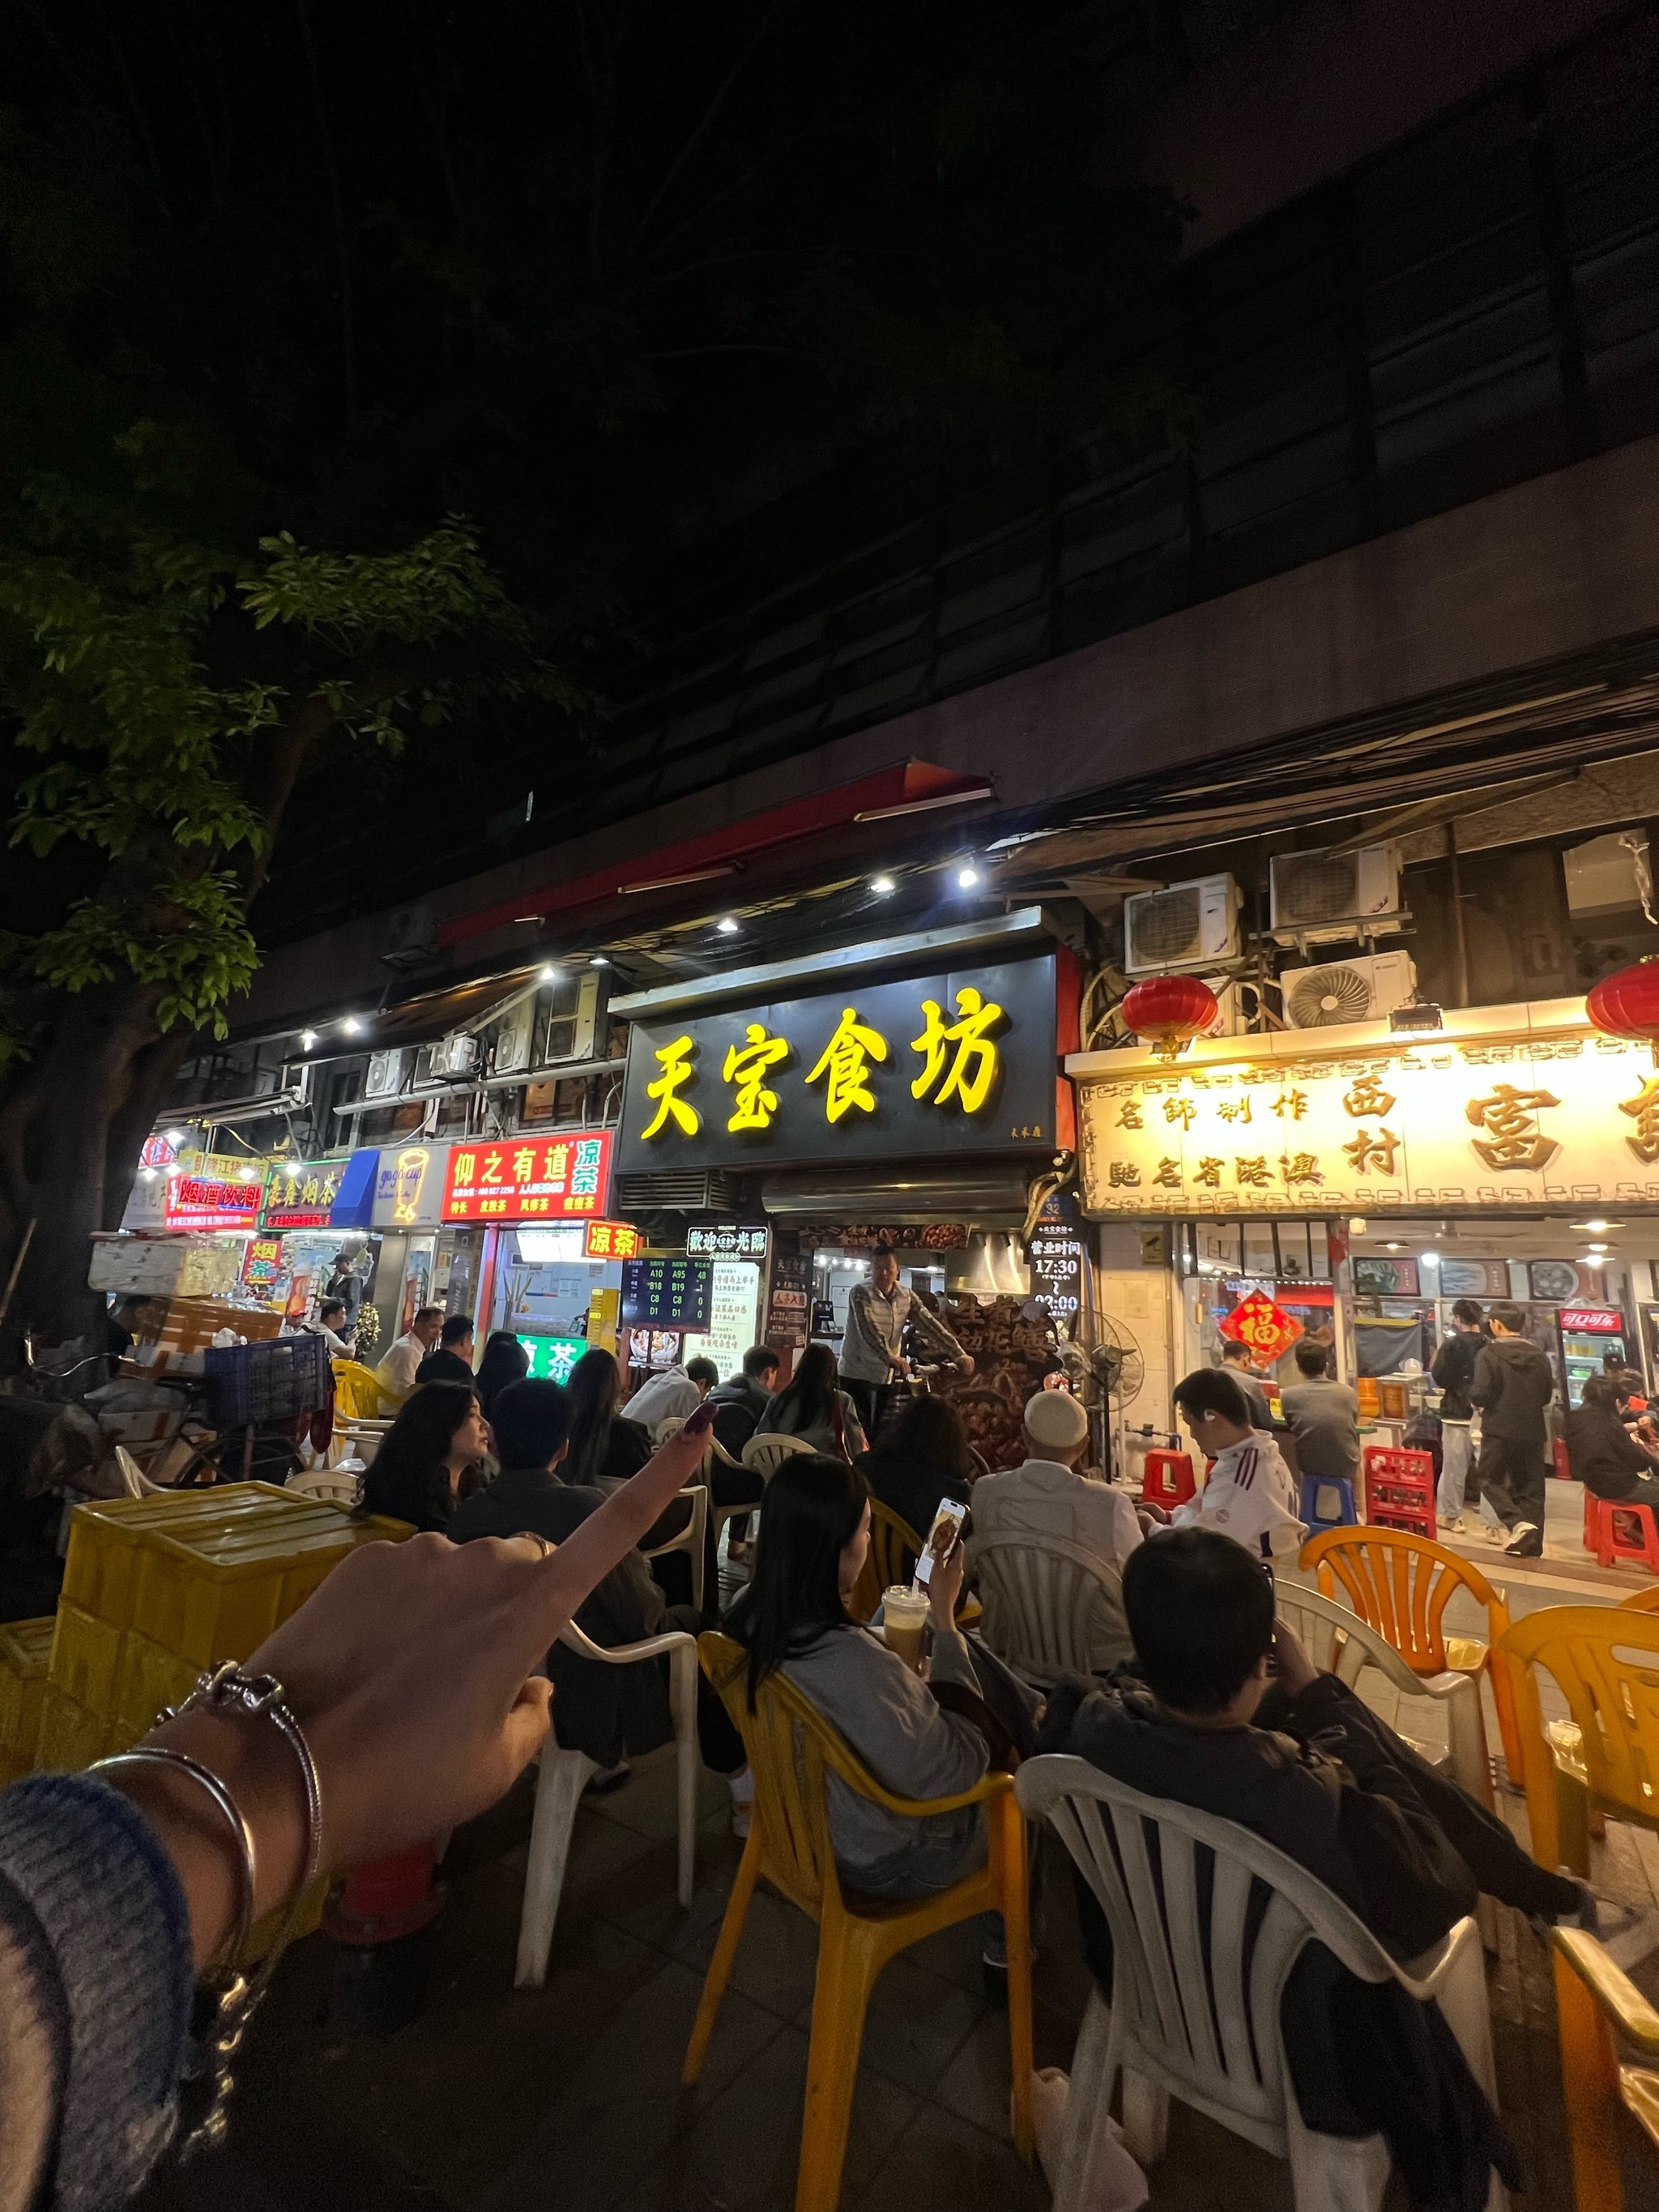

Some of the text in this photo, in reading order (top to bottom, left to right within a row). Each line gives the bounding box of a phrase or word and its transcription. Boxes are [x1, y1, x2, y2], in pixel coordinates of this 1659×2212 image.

[640, 987, 1003, 1140] 天宝食坊
[1341, 1075, 1402, 1177] 西村
[454, 1143, 569, 1186] 仰之有道
[571, 1138, 602, 1194] 凉茶
[181, 1181, 259, 1209] 烟酒饮料
[590, 1226, 635, 1255] 凉茶
[1031, 1240, 1081, 1256] 营业时间
[650, 1269, 663, 1278] A10
[672, 1269, 686, 1279] A95
[697, 1270, 706, 1280] 48
[1035, 1259, 1077, 1275] 17:30
[649, 1281, 662, 1290] B18
[672, 1282, 685, 1292] B19
[650, 1294, 659, 1303] C8
[673, 1295, 682, 1305] C8
[650, 1306, 658, 1315] D1
[672, 1308, 681, 1317] D1
[1562, 1313, 1618, 1327] 可口可乐
[1239, 1302, 1281, 1345] 福
